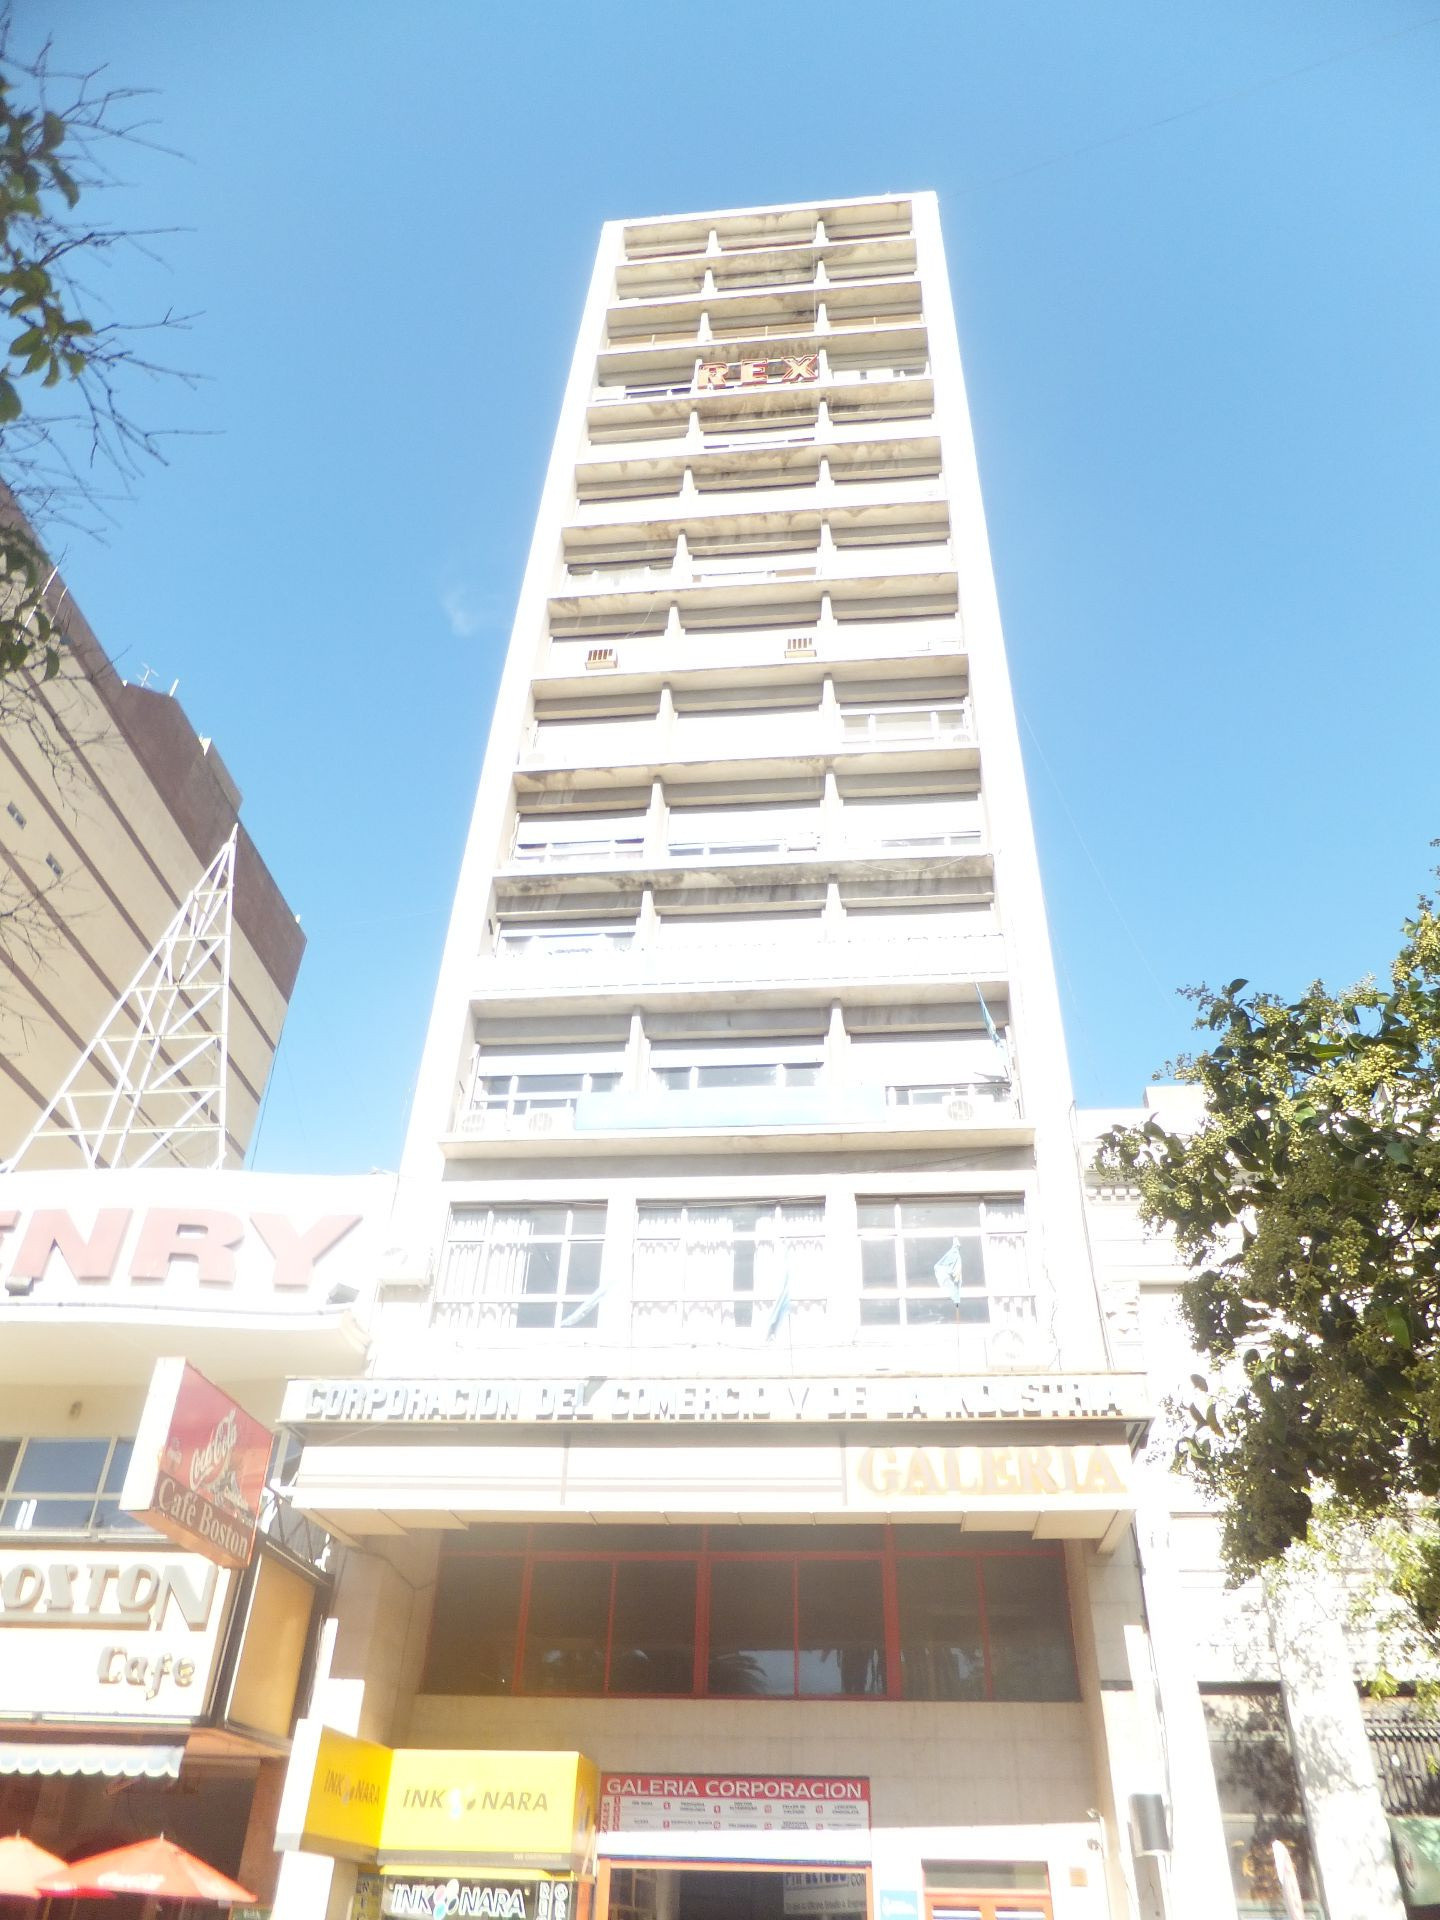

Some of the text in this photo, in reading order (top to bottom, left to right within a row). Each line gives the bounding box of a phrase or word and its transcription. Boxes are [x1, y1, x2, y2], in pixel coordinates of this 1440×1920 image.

[699, 353, 818, 390] REX
[304, 1382, 522, 1420] CORPORACION
[535, 1382, 594, 1420] DEL
[610, 1382, 772, 1420] COMERCIO
[827, 1382, 869, 1420] DE
[857, 1446, 1129, 1496] GALERIA
[158, 1477, 197, 1524] Café
[198, 1503, 249, 1558] Boston
[0, 1563, 219, 1630] OSTON
[97, 1645, 196, 1701] Cafe
[323, 1768, 380, 1805] INK NARA
[402, 1788, 549, 1811] INK NARA
[606, 1778, 863, 1799] GALERIA CORPORACION
[390, 1883, 438, 1915] INK
[458, 1885, 527, 1919] NARA
